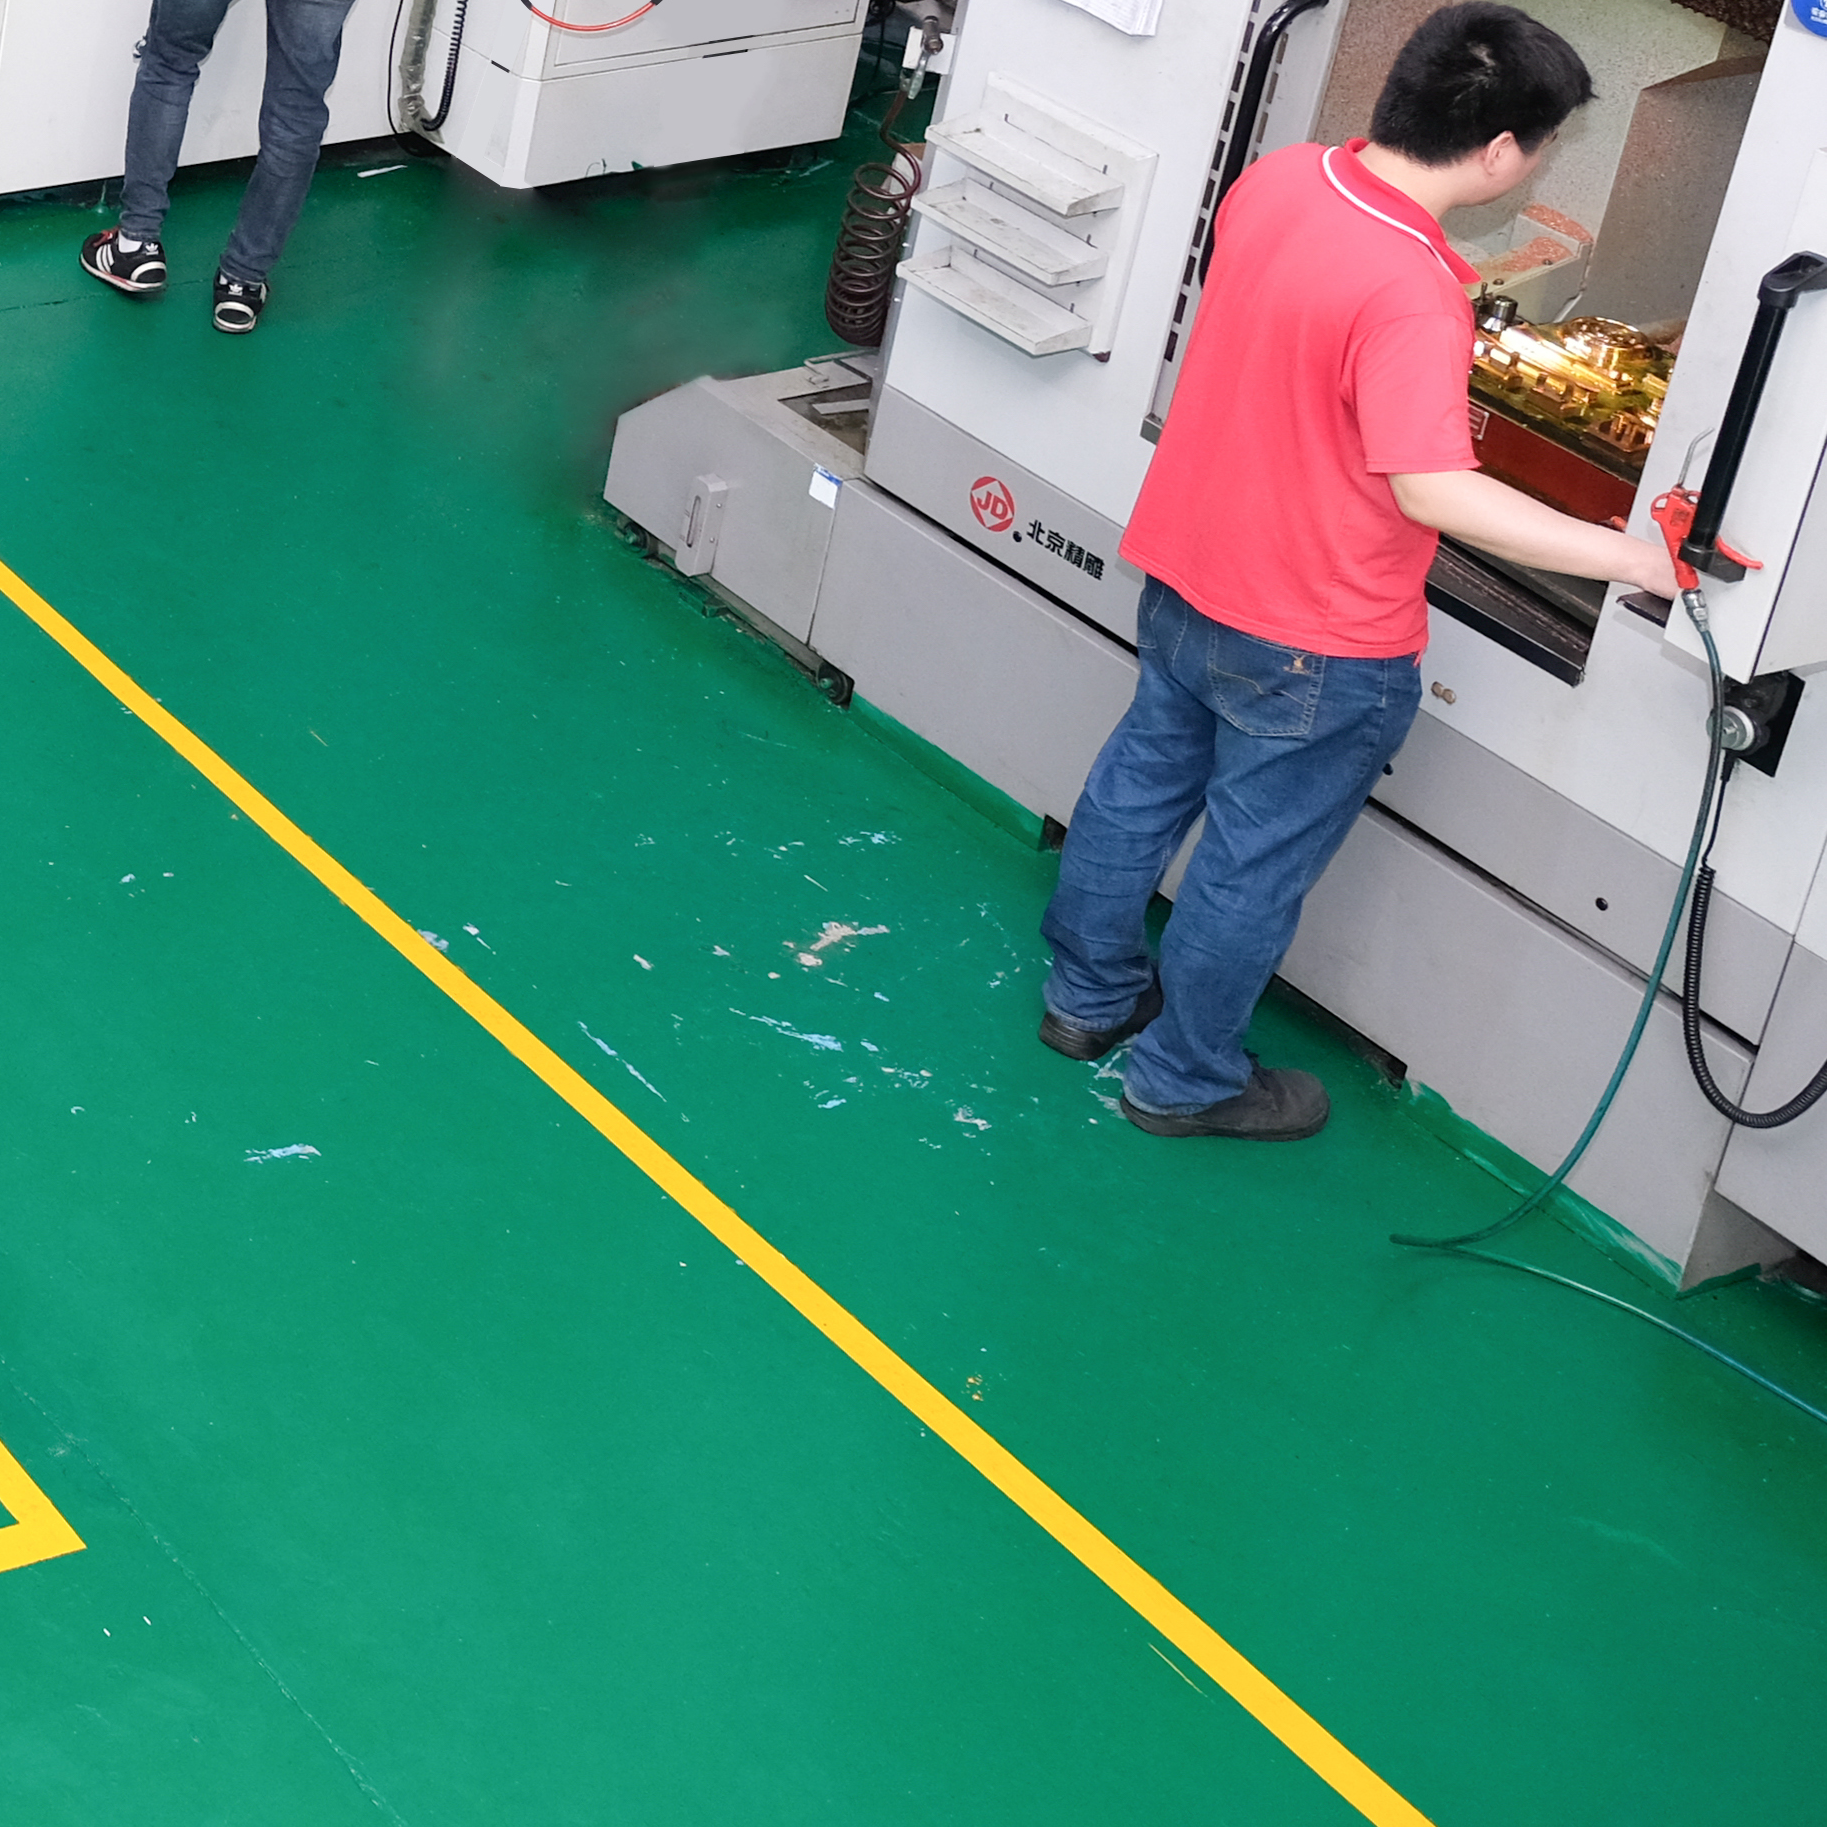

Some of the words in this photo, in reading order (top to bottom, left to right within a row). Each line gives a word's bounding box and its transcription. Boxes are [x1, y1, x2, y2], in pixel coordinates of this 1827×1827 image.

[976, 490, 1009, 521] JD
[1026, 519, 1106, 581] 北京精雕
